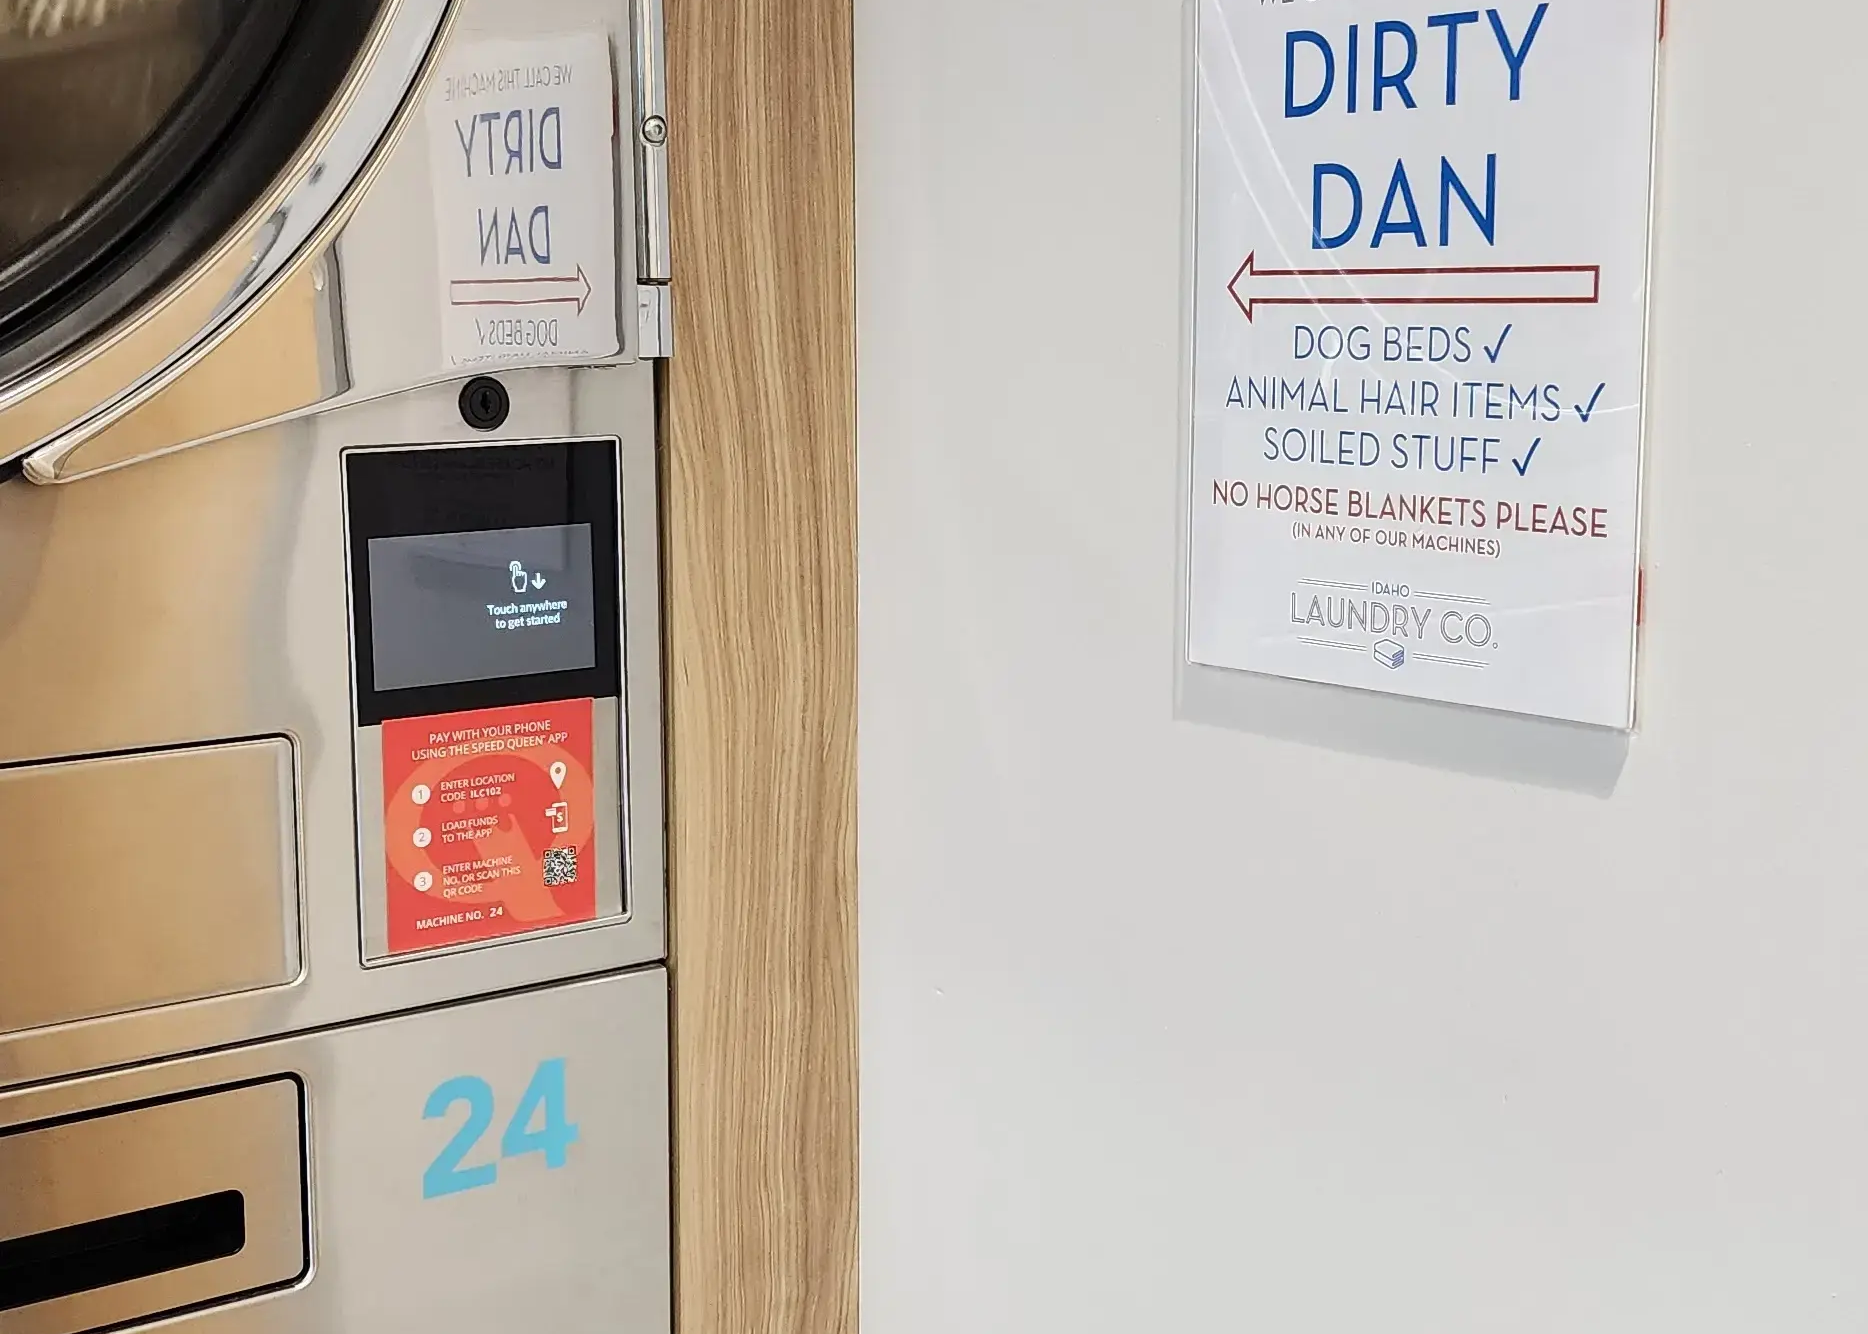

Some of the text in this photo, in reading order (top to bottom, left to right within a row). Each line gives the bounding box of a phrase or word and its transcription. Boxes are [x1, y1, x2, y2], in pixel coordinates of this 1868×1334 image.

[1284, 3, 1549, 118] DIRTY
[1312, 153, 1496, 249] DAN
[1294, 325, 1471, 363] DOG BEDS
[1226, 375, 1560, 421] ANIMAL HAIR ITEMS
[1264, 427, 1500, 474] SOILED STUFF
[1213, 479, 1608, 538] NO HORSE BLANKETS PLEASE
[1292, 522, 1500, 558] (IN ANY OF OUR MACHINES)
[1371, 582, 1410, 597] IDAHO
[486, 599, 568, 616] Touch anywhere
[496, 612, 561, 630] to get started
[1291, 592, 1499, 649] LAUNDRY CO.
[430, 720, 551, 745] PAY WITH YOUR PHONE
[411, 746, 447, 761] USING
[449, 744, 469, 756] THE
[471, 740, 505, 754] SPEED
[548, 732, 569, 744] APP
[441, 773, 516, 791] ENTER LOCATION
[441, 791, 467, 803] CODE
[442, 815, 499, 832] LOAD FUNDS
[442, 828, 493, 844] TO THE APP
[443, 855, 513, 875] ENTER MACHINE
[462, 872, 476, 883] OR
[476, 868, 501, 881] SCAN
[500, 866, 522, 877] THIS
[443, 883, 484, 899] QR CODE
[416, 906, 504, 930] MACHINE NO. 24
[422, 1056, 579, 1200] 24
